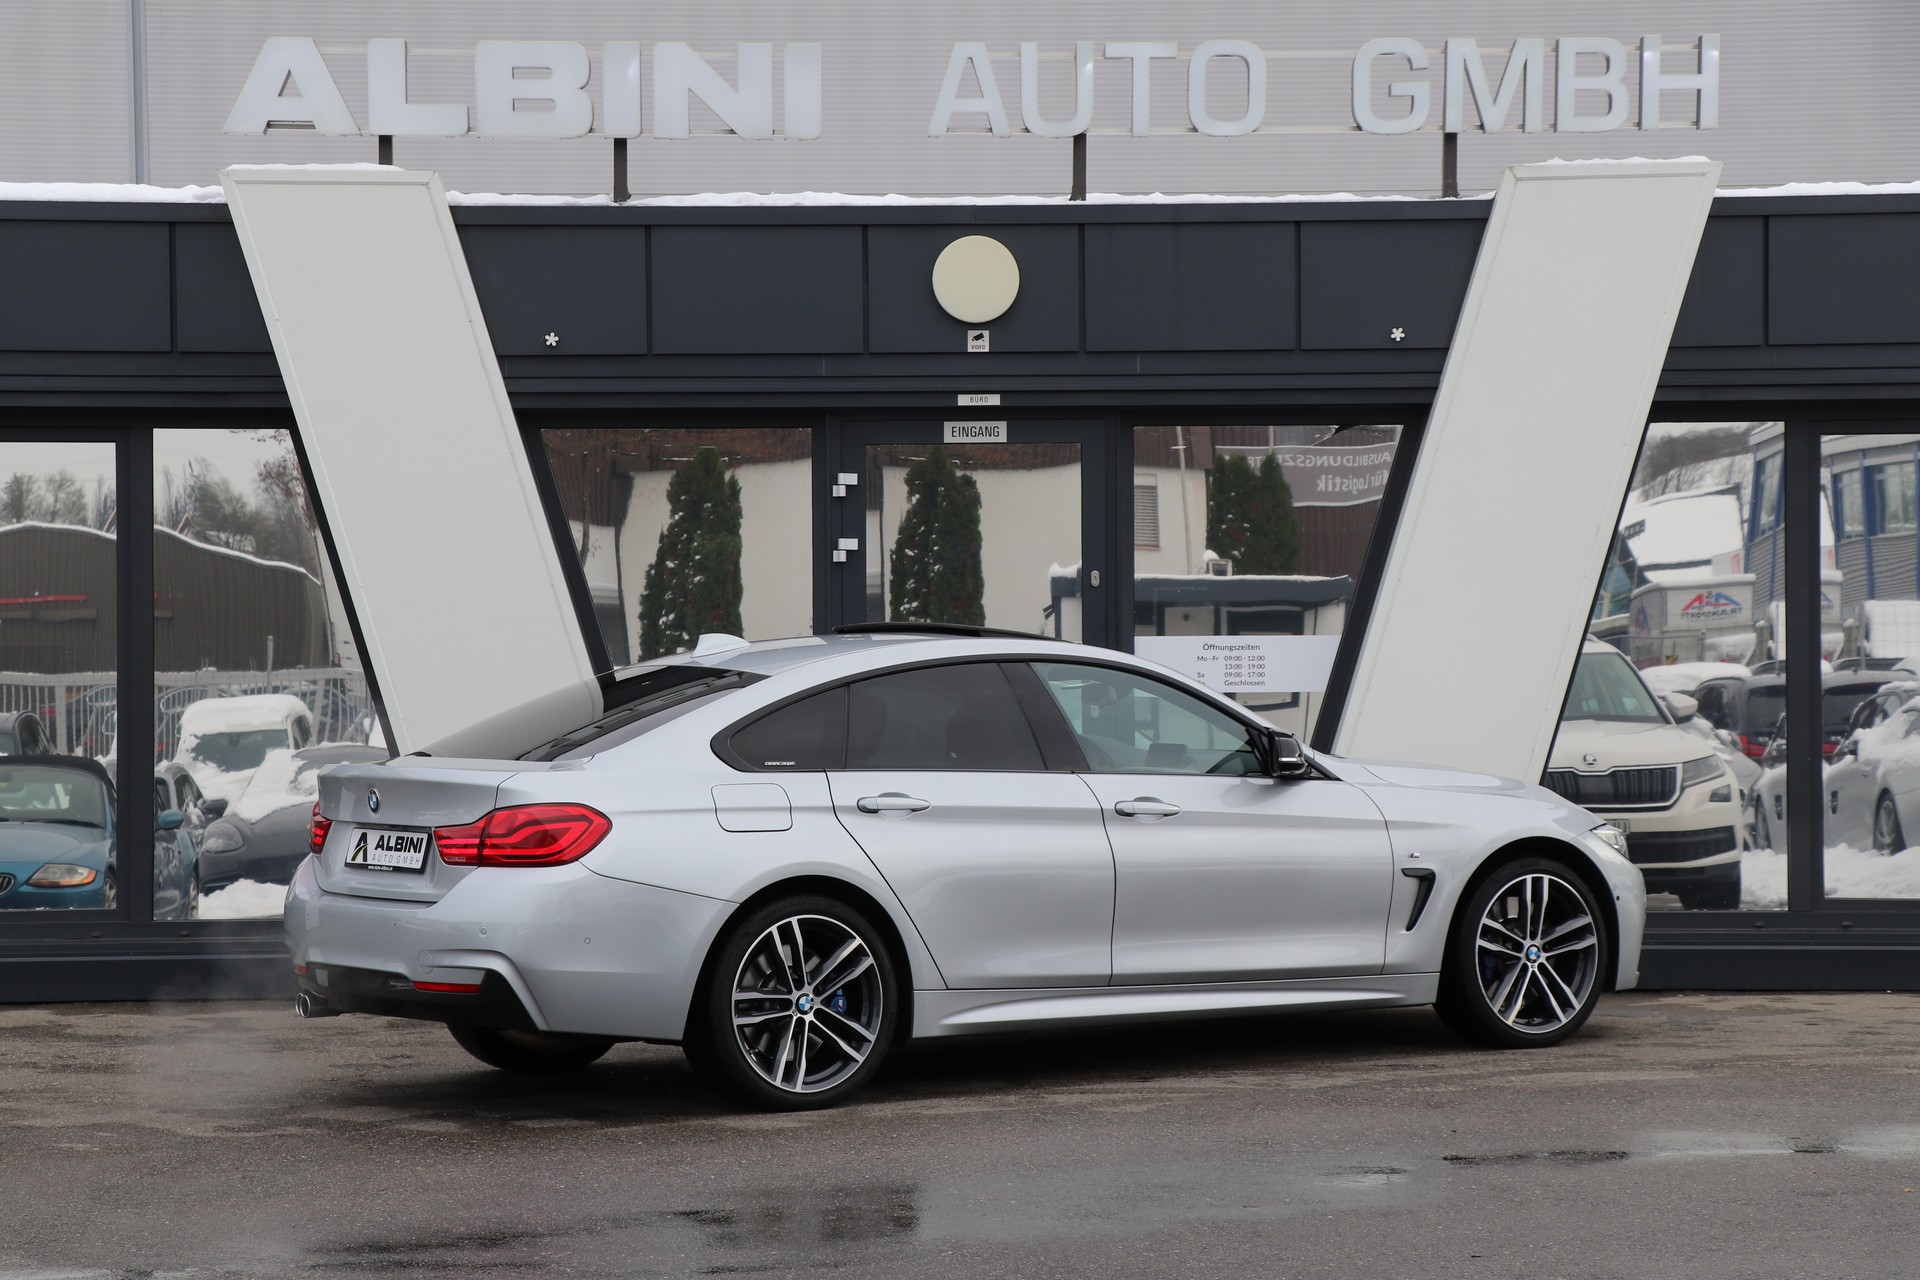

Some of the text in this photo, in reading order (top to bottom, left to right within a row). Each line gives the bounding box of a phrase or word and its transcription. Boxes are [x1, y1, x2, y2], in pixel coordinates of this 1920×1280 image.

[223, 33, 1720, 141] ALBINI AUTO GMBH
[969, 395, 989, 403] BÜRO
[951, 426, 1000, 438] EINGANG
[1203, 643, 1260, 652] Öffnungszeiten
[374, 835, 424, 853] ALBINI
[372, 854, 420, 865] AUTO GMBH
